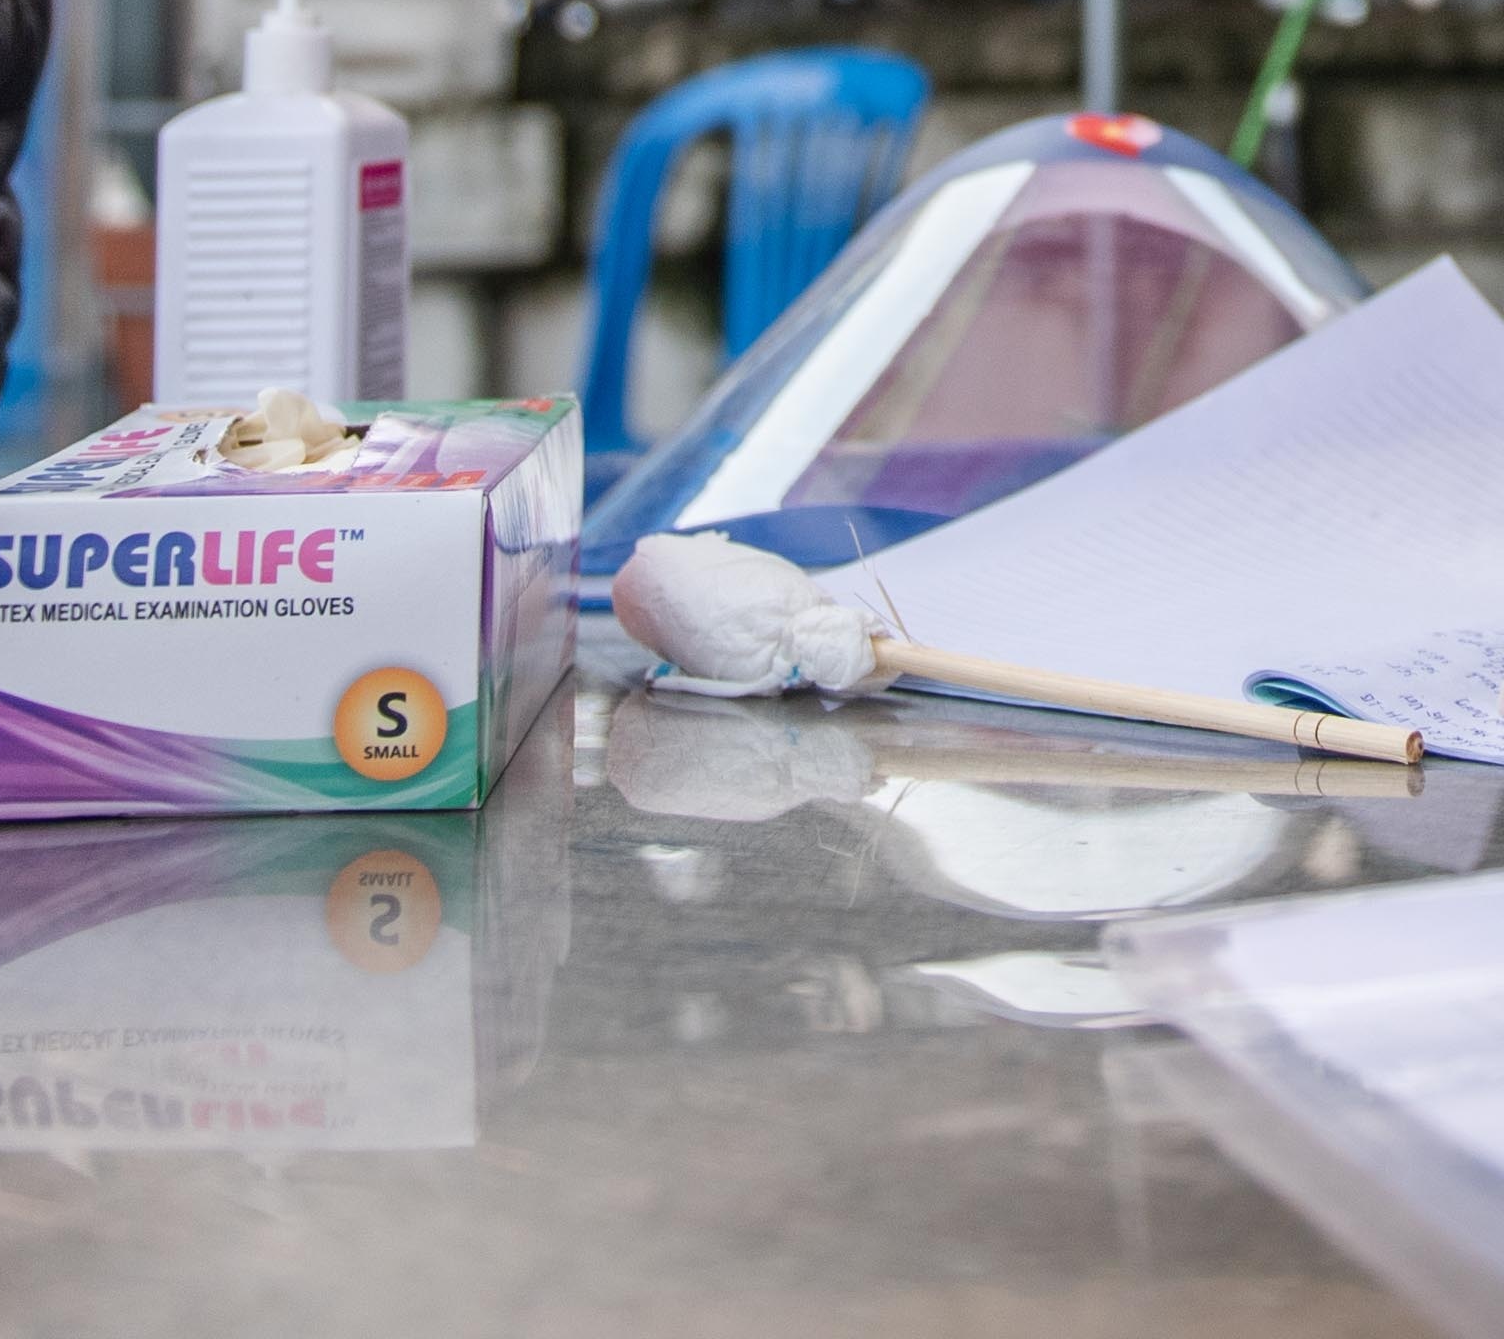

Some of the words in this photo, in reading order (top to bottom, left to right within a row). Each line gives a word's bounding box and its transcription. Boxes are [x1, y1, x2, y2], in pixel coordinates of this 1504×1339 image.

[41, 601, 128, 622] MEDICAL
[134, 598, 268, 621] EXAMINATION
[274, 596, 354, 617] GLOVES
[376, 691, 409, 739] S
[363, 745, 420, 761] SMALL
